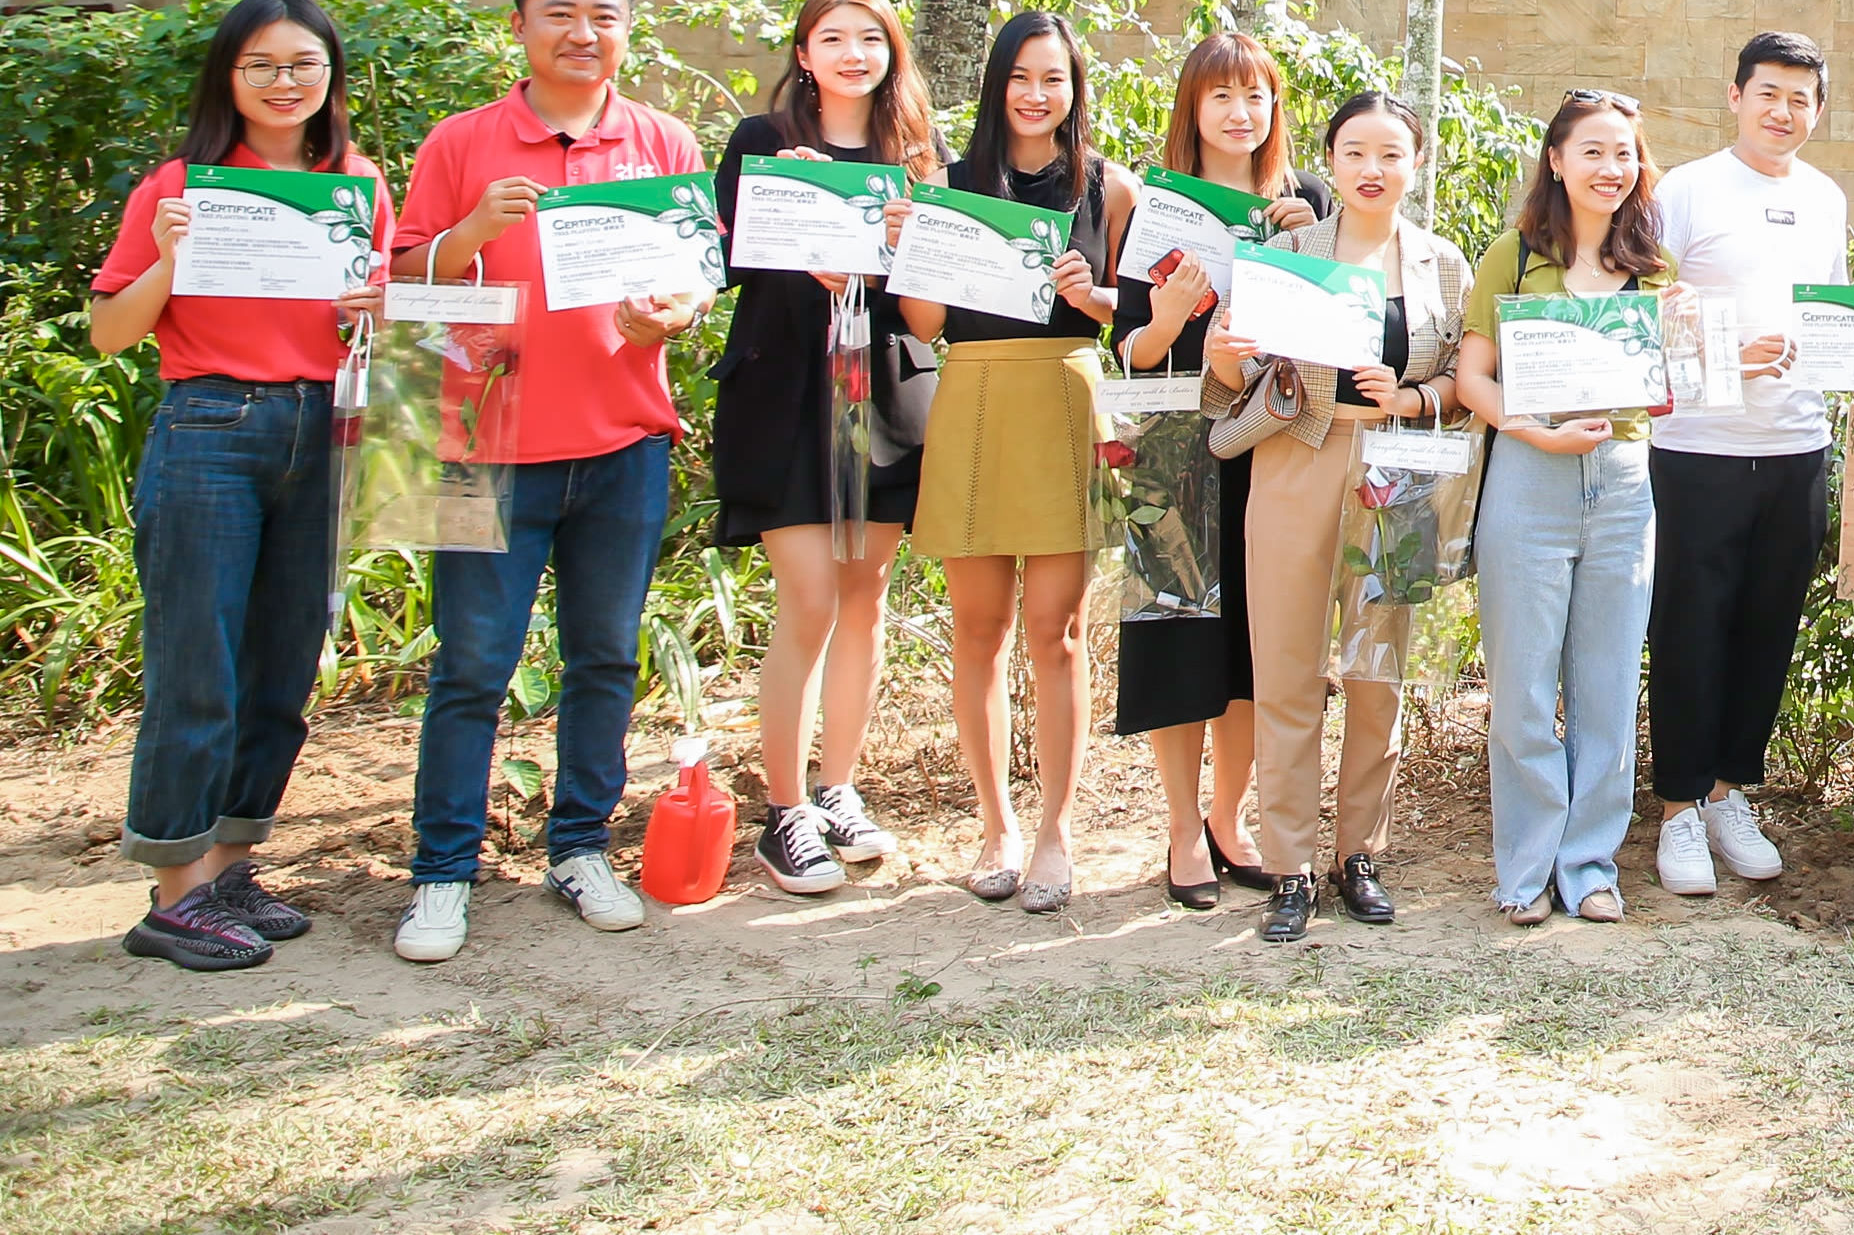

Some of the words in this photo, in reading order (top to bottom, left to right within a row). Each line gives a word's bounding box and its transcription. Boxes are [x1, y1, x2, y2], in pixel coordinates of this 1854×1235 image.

[751, 185, 818, 198] CERTIFICATE
[198, 200, 277, 215] CERTIFICATE
[1149, 197, 1204, 221] CERTIFICATE
[552, 215, 624, 230] CERTIFICATE
[918, 214, 981, 236] CERTIFICATE
[1513, 331, 1576, 340] CERTIFICATE
